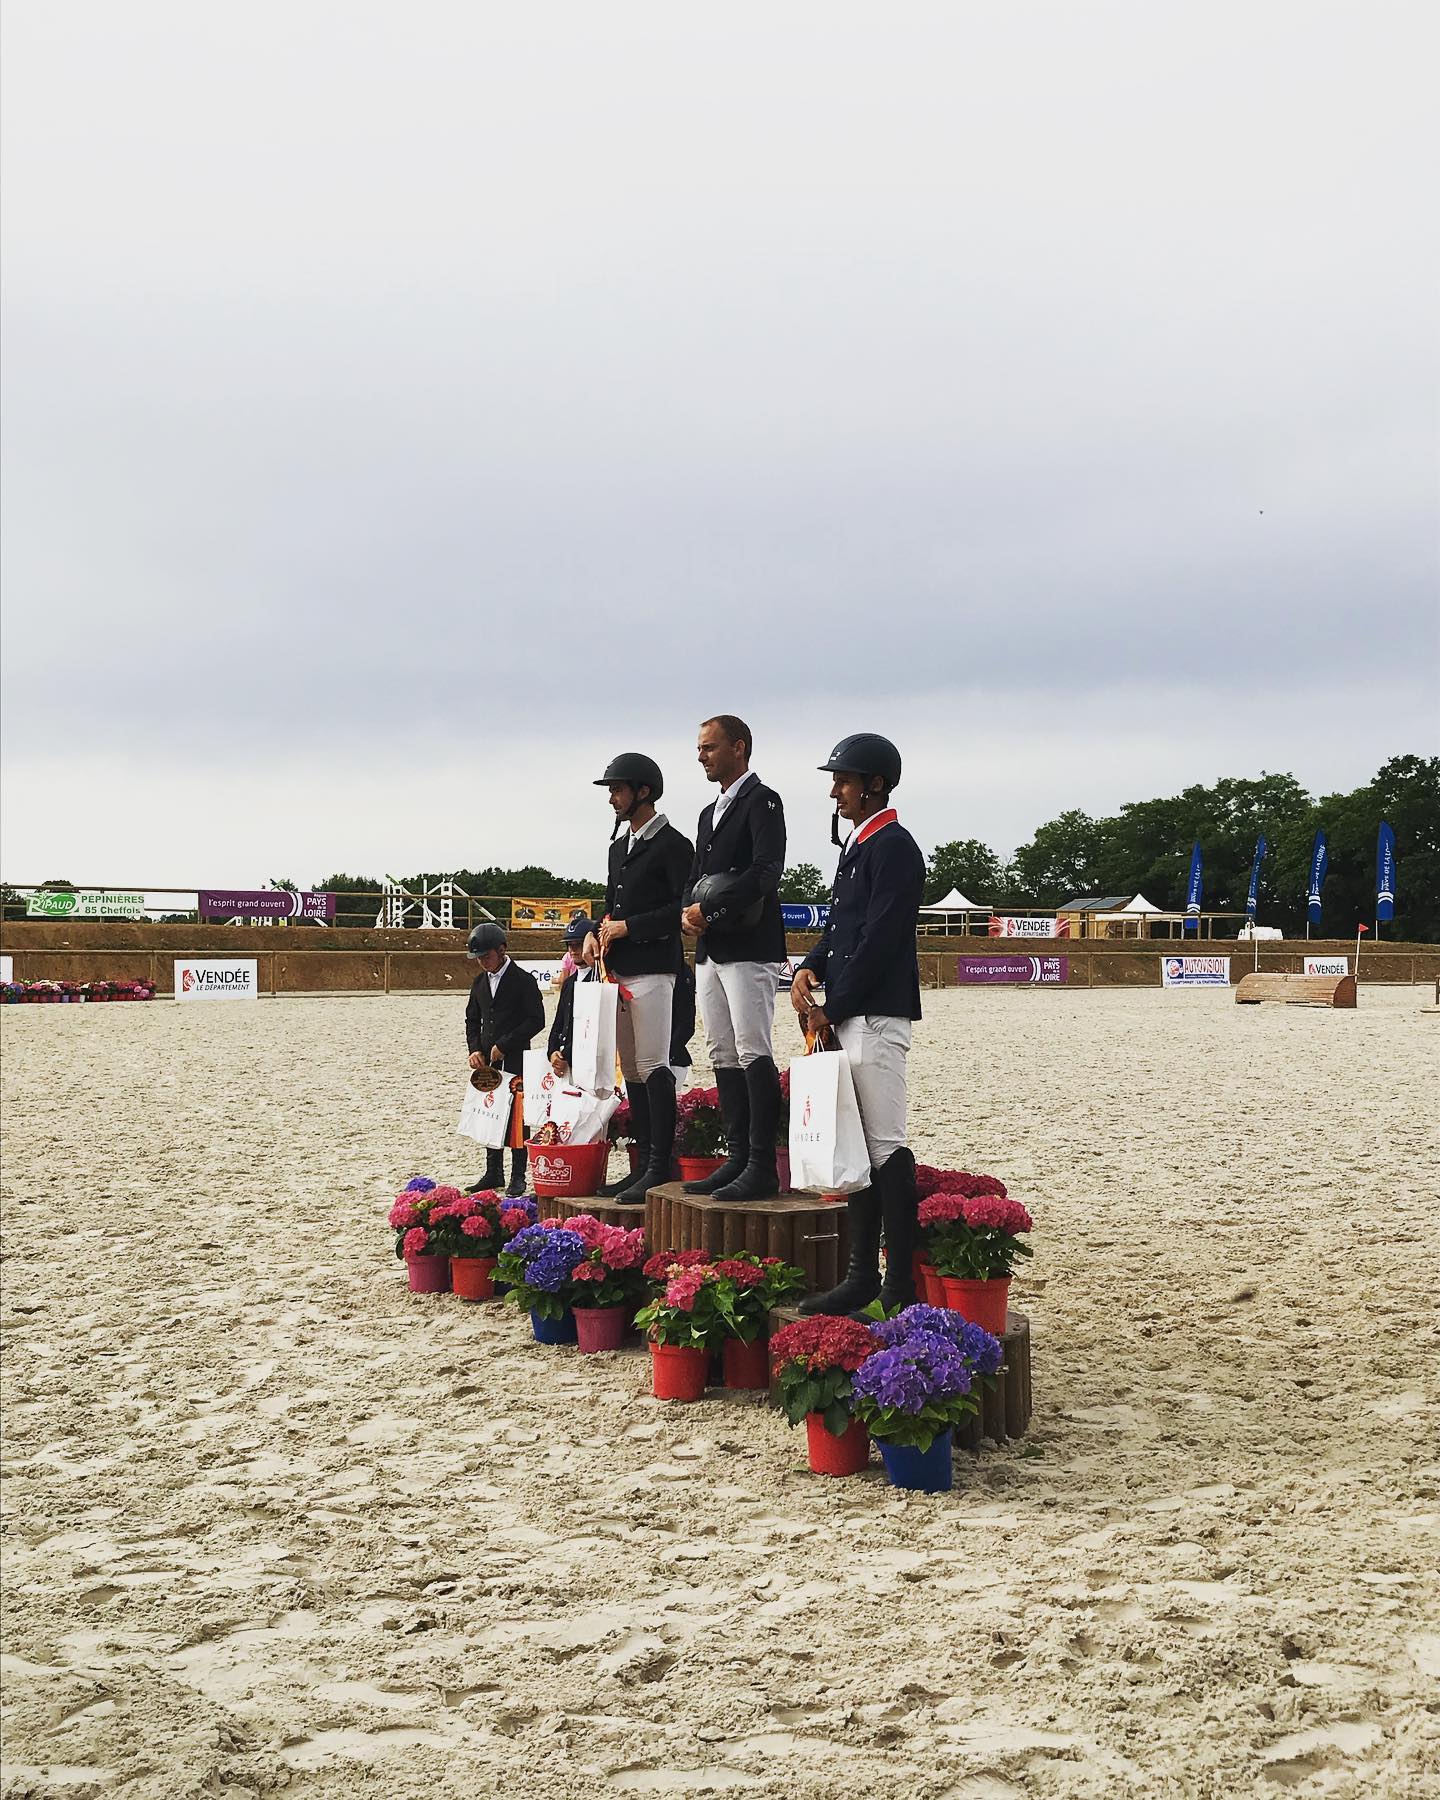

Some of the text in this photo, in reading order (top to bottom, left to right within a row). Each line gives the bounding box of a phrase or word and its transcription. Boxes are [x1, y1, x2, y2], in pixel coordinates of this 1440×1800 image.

[209, 899, 286, 909] l'esprit grand ouvert
[306, 897, 327, 906] PAYS
[85, 906, 141, 914] 85 Cheffois
[304, 909, 327, 917] LOIRE
[1016, 919, 1050, 931] VENDÉE
[989, 965, 1007, 974] grand
[1008, 965, 1028, 973] ouvert
[1044, 962, 1060, 970] PAYS
[1185, 959, 1225, 973] AUTOVISION
[195, 968, 250, 984] VENDÉE
[1042, 973, 1060, 981] LOIRE
